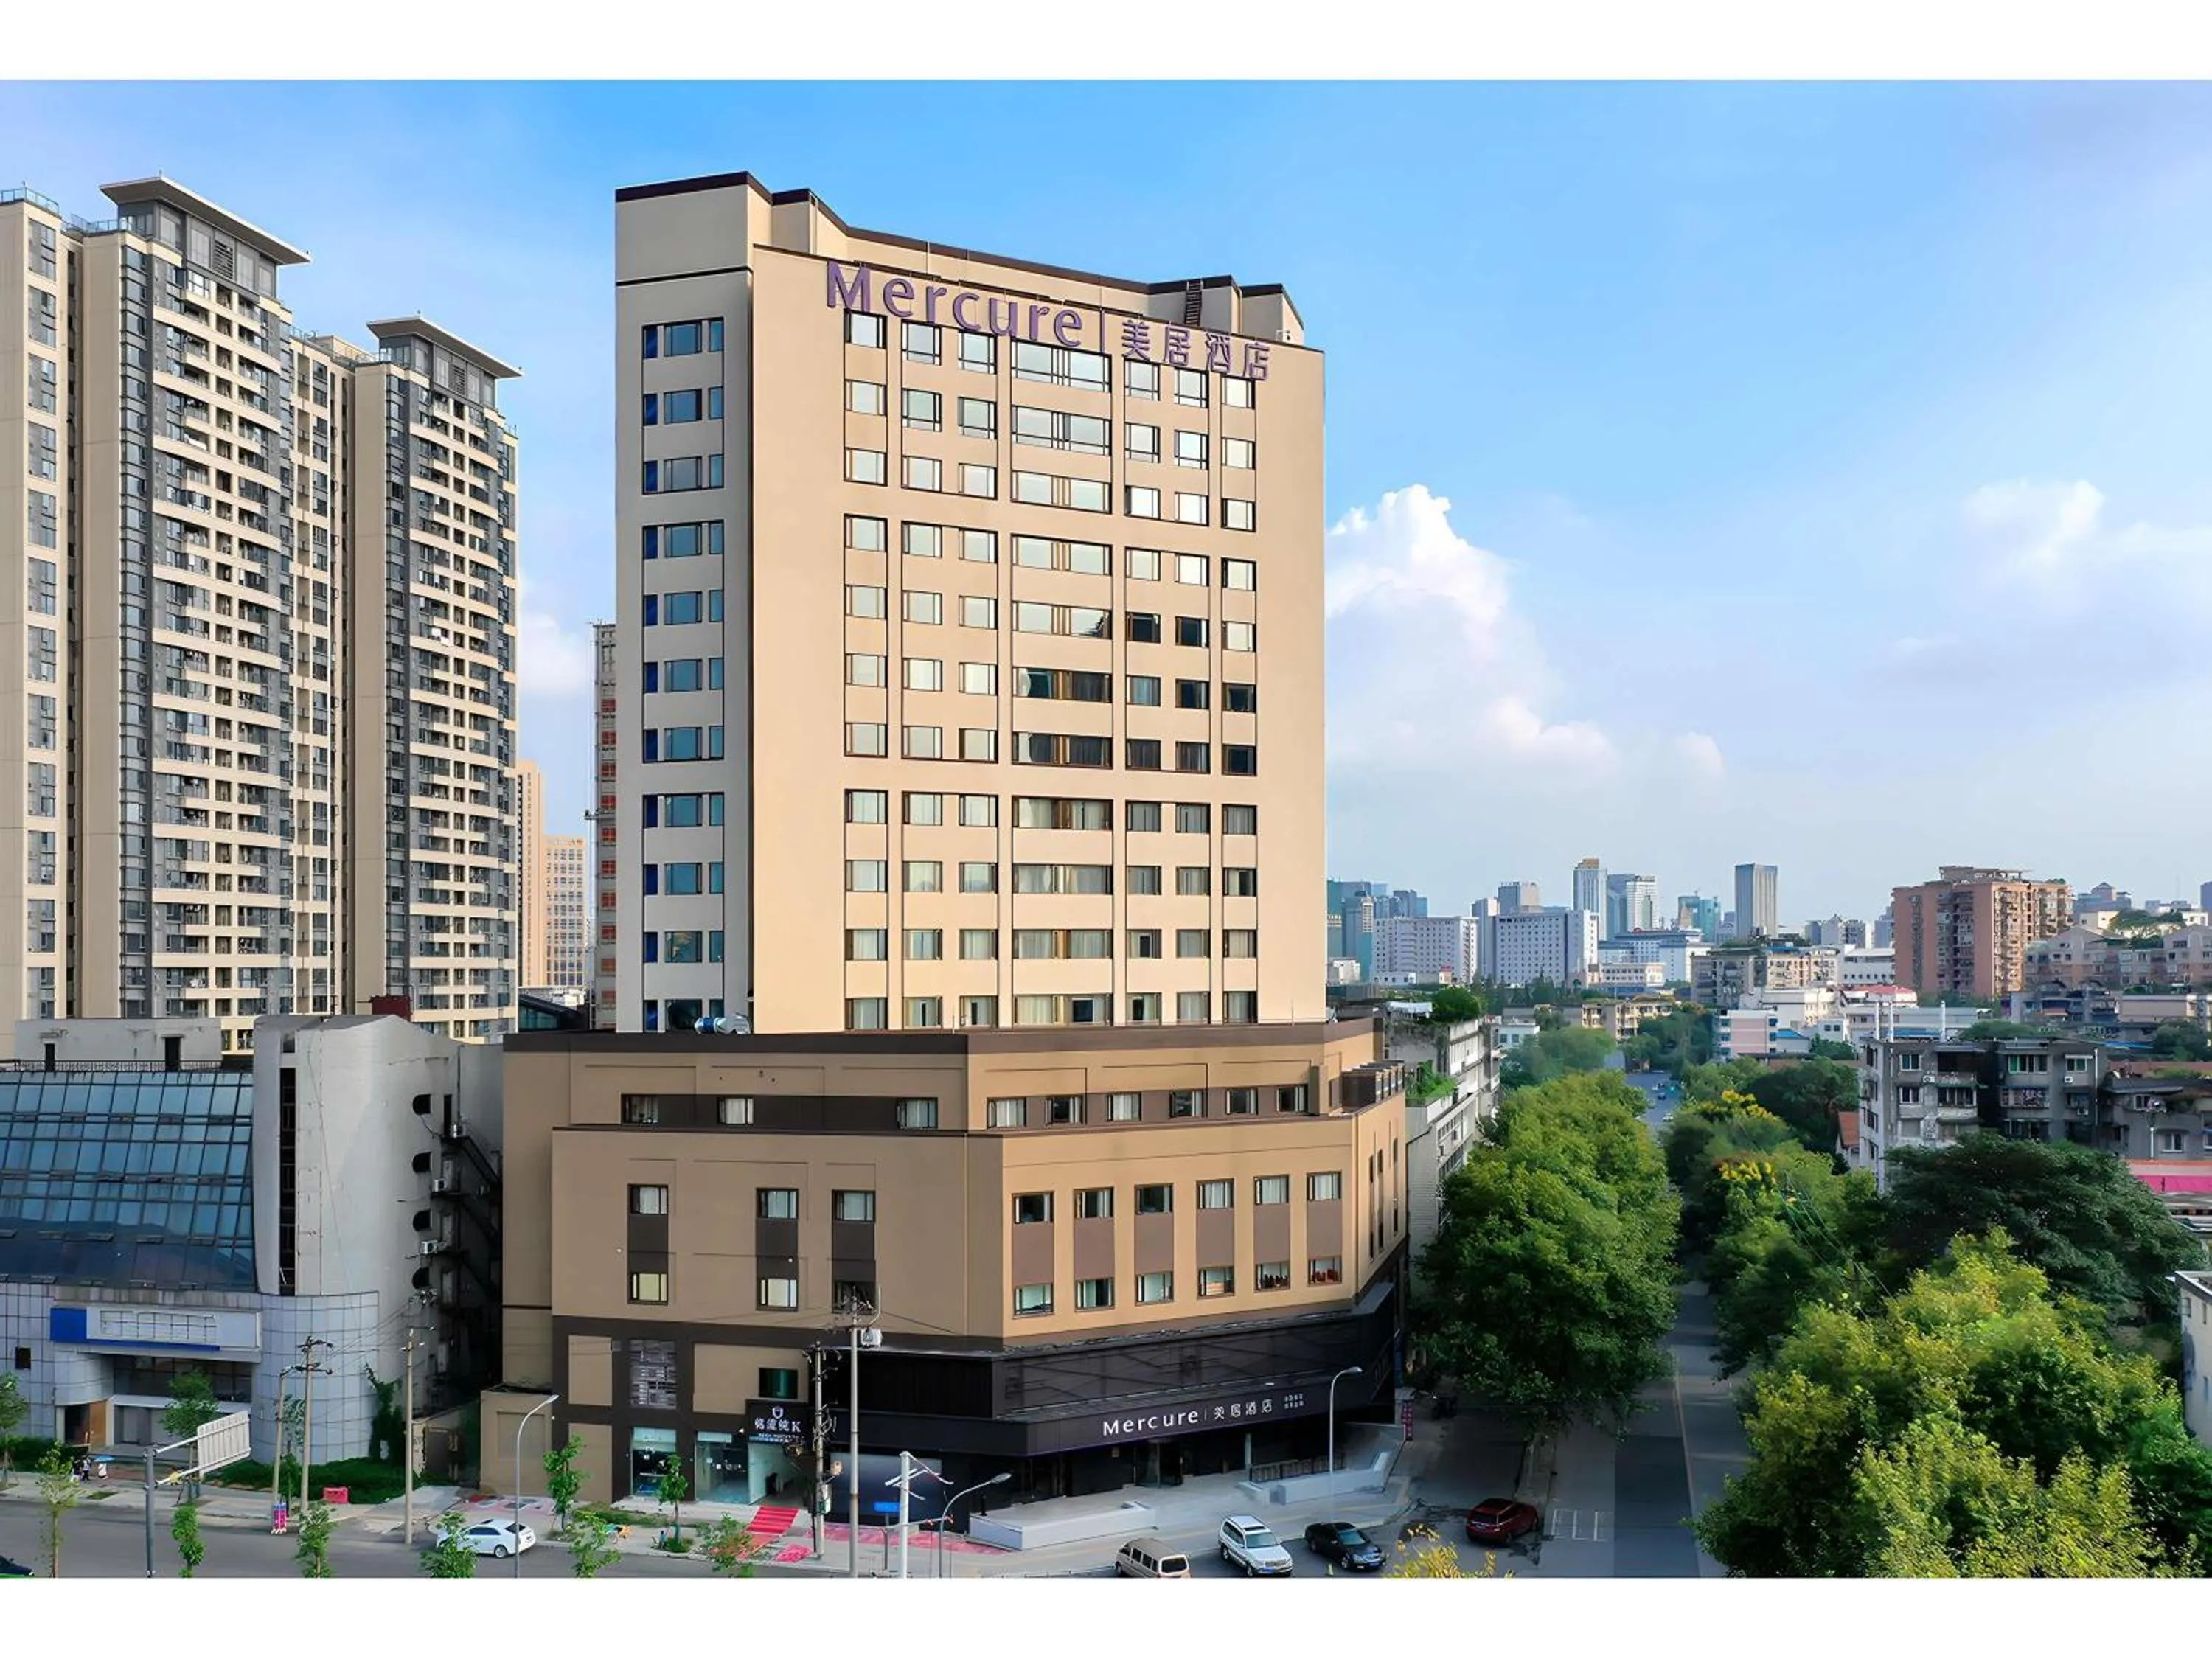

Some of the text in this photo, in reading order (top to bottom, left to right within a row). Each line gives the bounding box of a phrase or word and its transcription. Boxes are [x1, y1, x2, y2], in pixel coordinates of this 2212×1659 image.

[827, 260, 1270, 381] Mercure 美居酒店
[1102, 1410, 1198, 1436] Mercure
